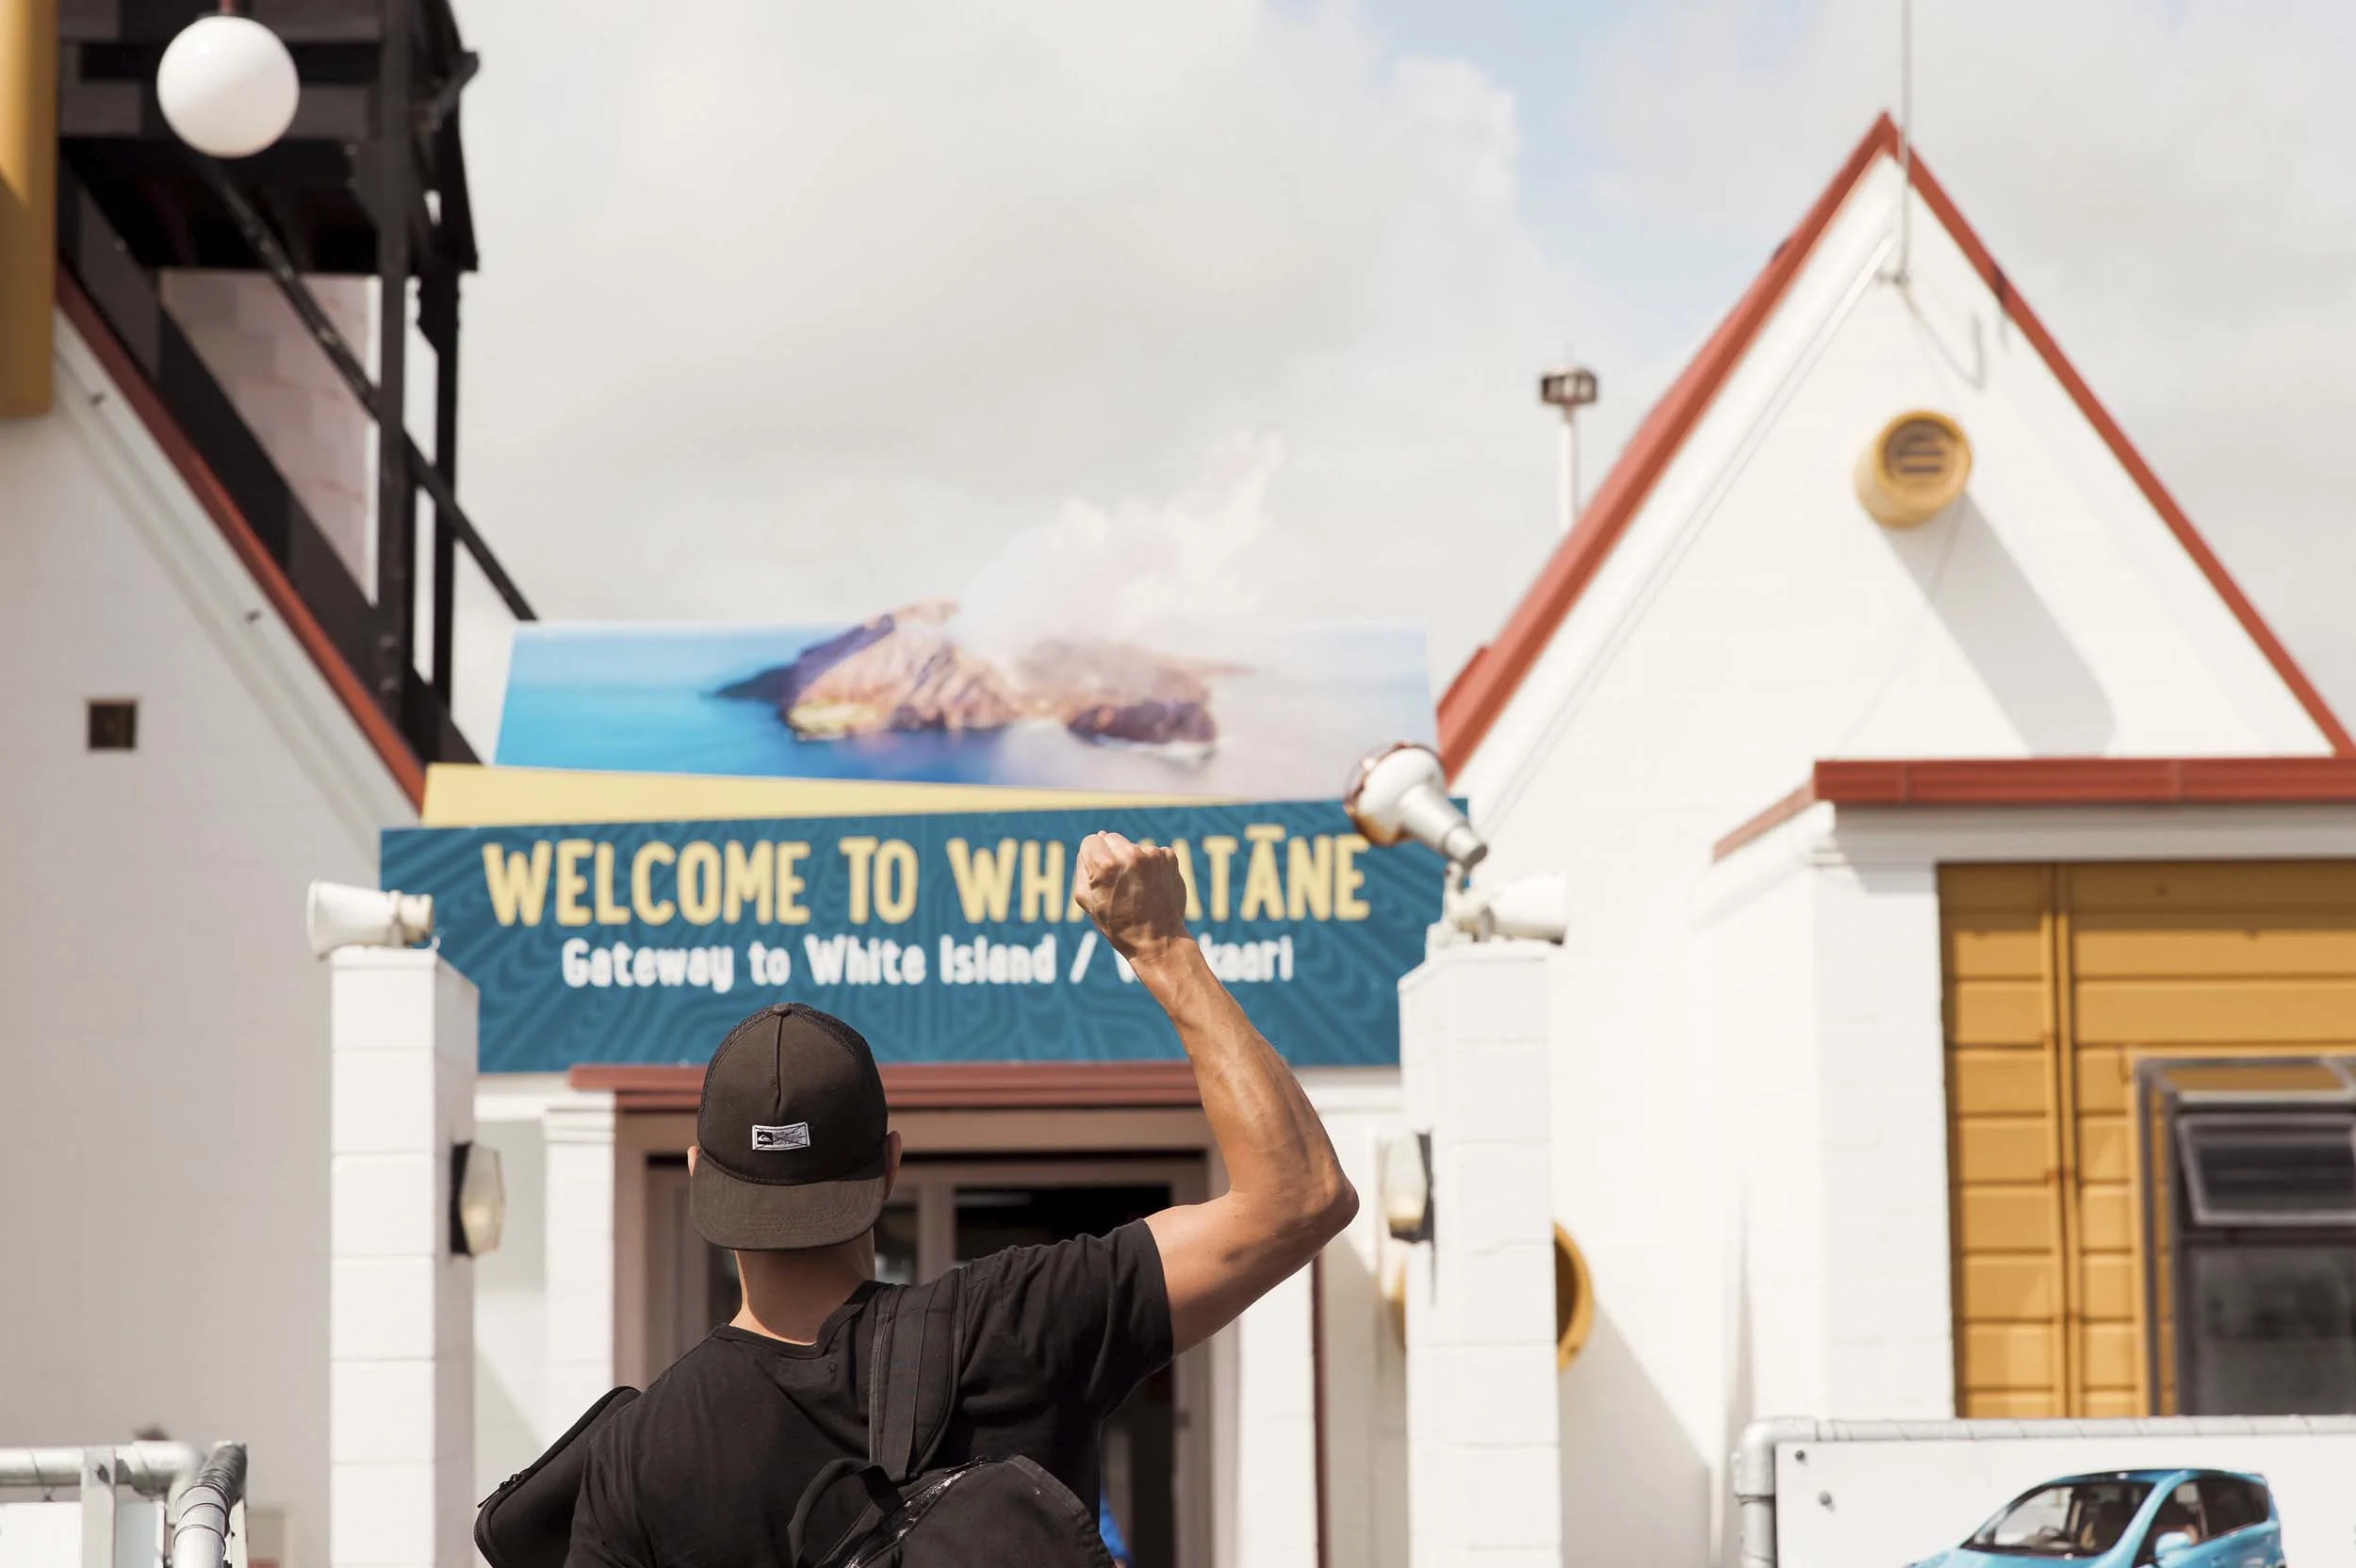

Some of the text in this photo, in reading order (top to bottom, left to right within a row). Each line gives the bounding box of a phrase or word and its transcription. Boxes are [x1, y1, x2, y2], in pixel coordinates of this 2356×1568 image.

[483, 824, 1371, 926] WELCOME TO WHTĀNE
[562, 937, 734, 994] Gateway
[749, 940, 792, 987] to
[803, 933, 927, 987] White
[939, 932, 1057, 986] Island
[1112, 931, 1294, 984] kaari
